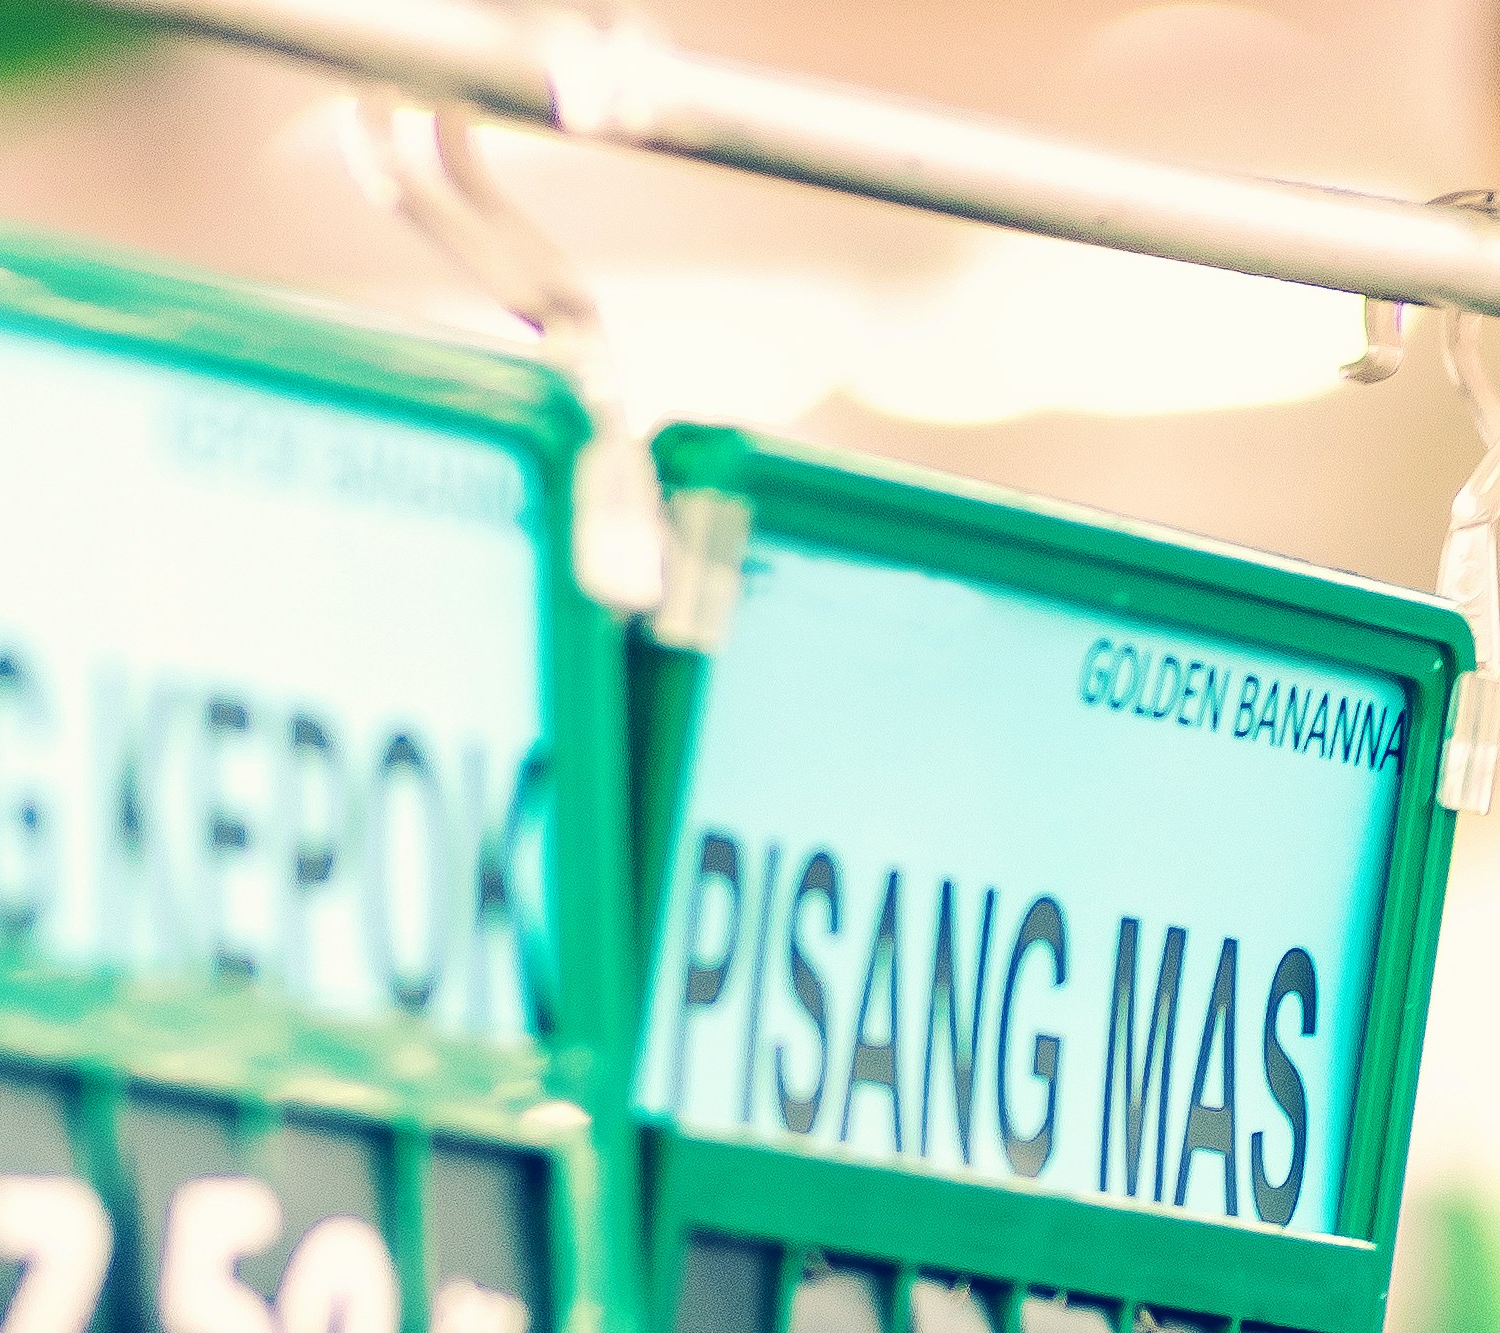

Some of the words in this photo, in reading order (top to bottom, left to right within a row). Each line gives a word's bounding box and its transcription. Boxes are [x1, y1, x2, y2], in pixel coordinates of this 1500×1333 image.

[80, 650, 556, 1038] KEPOK
[1078, 636, 1232, 732] GOLDEN
[1233, 674, 1406, 776] BANANNA
[672, 832, 1069, 1180] PISANG
[1097, 916, 1319, 1229] MAS
